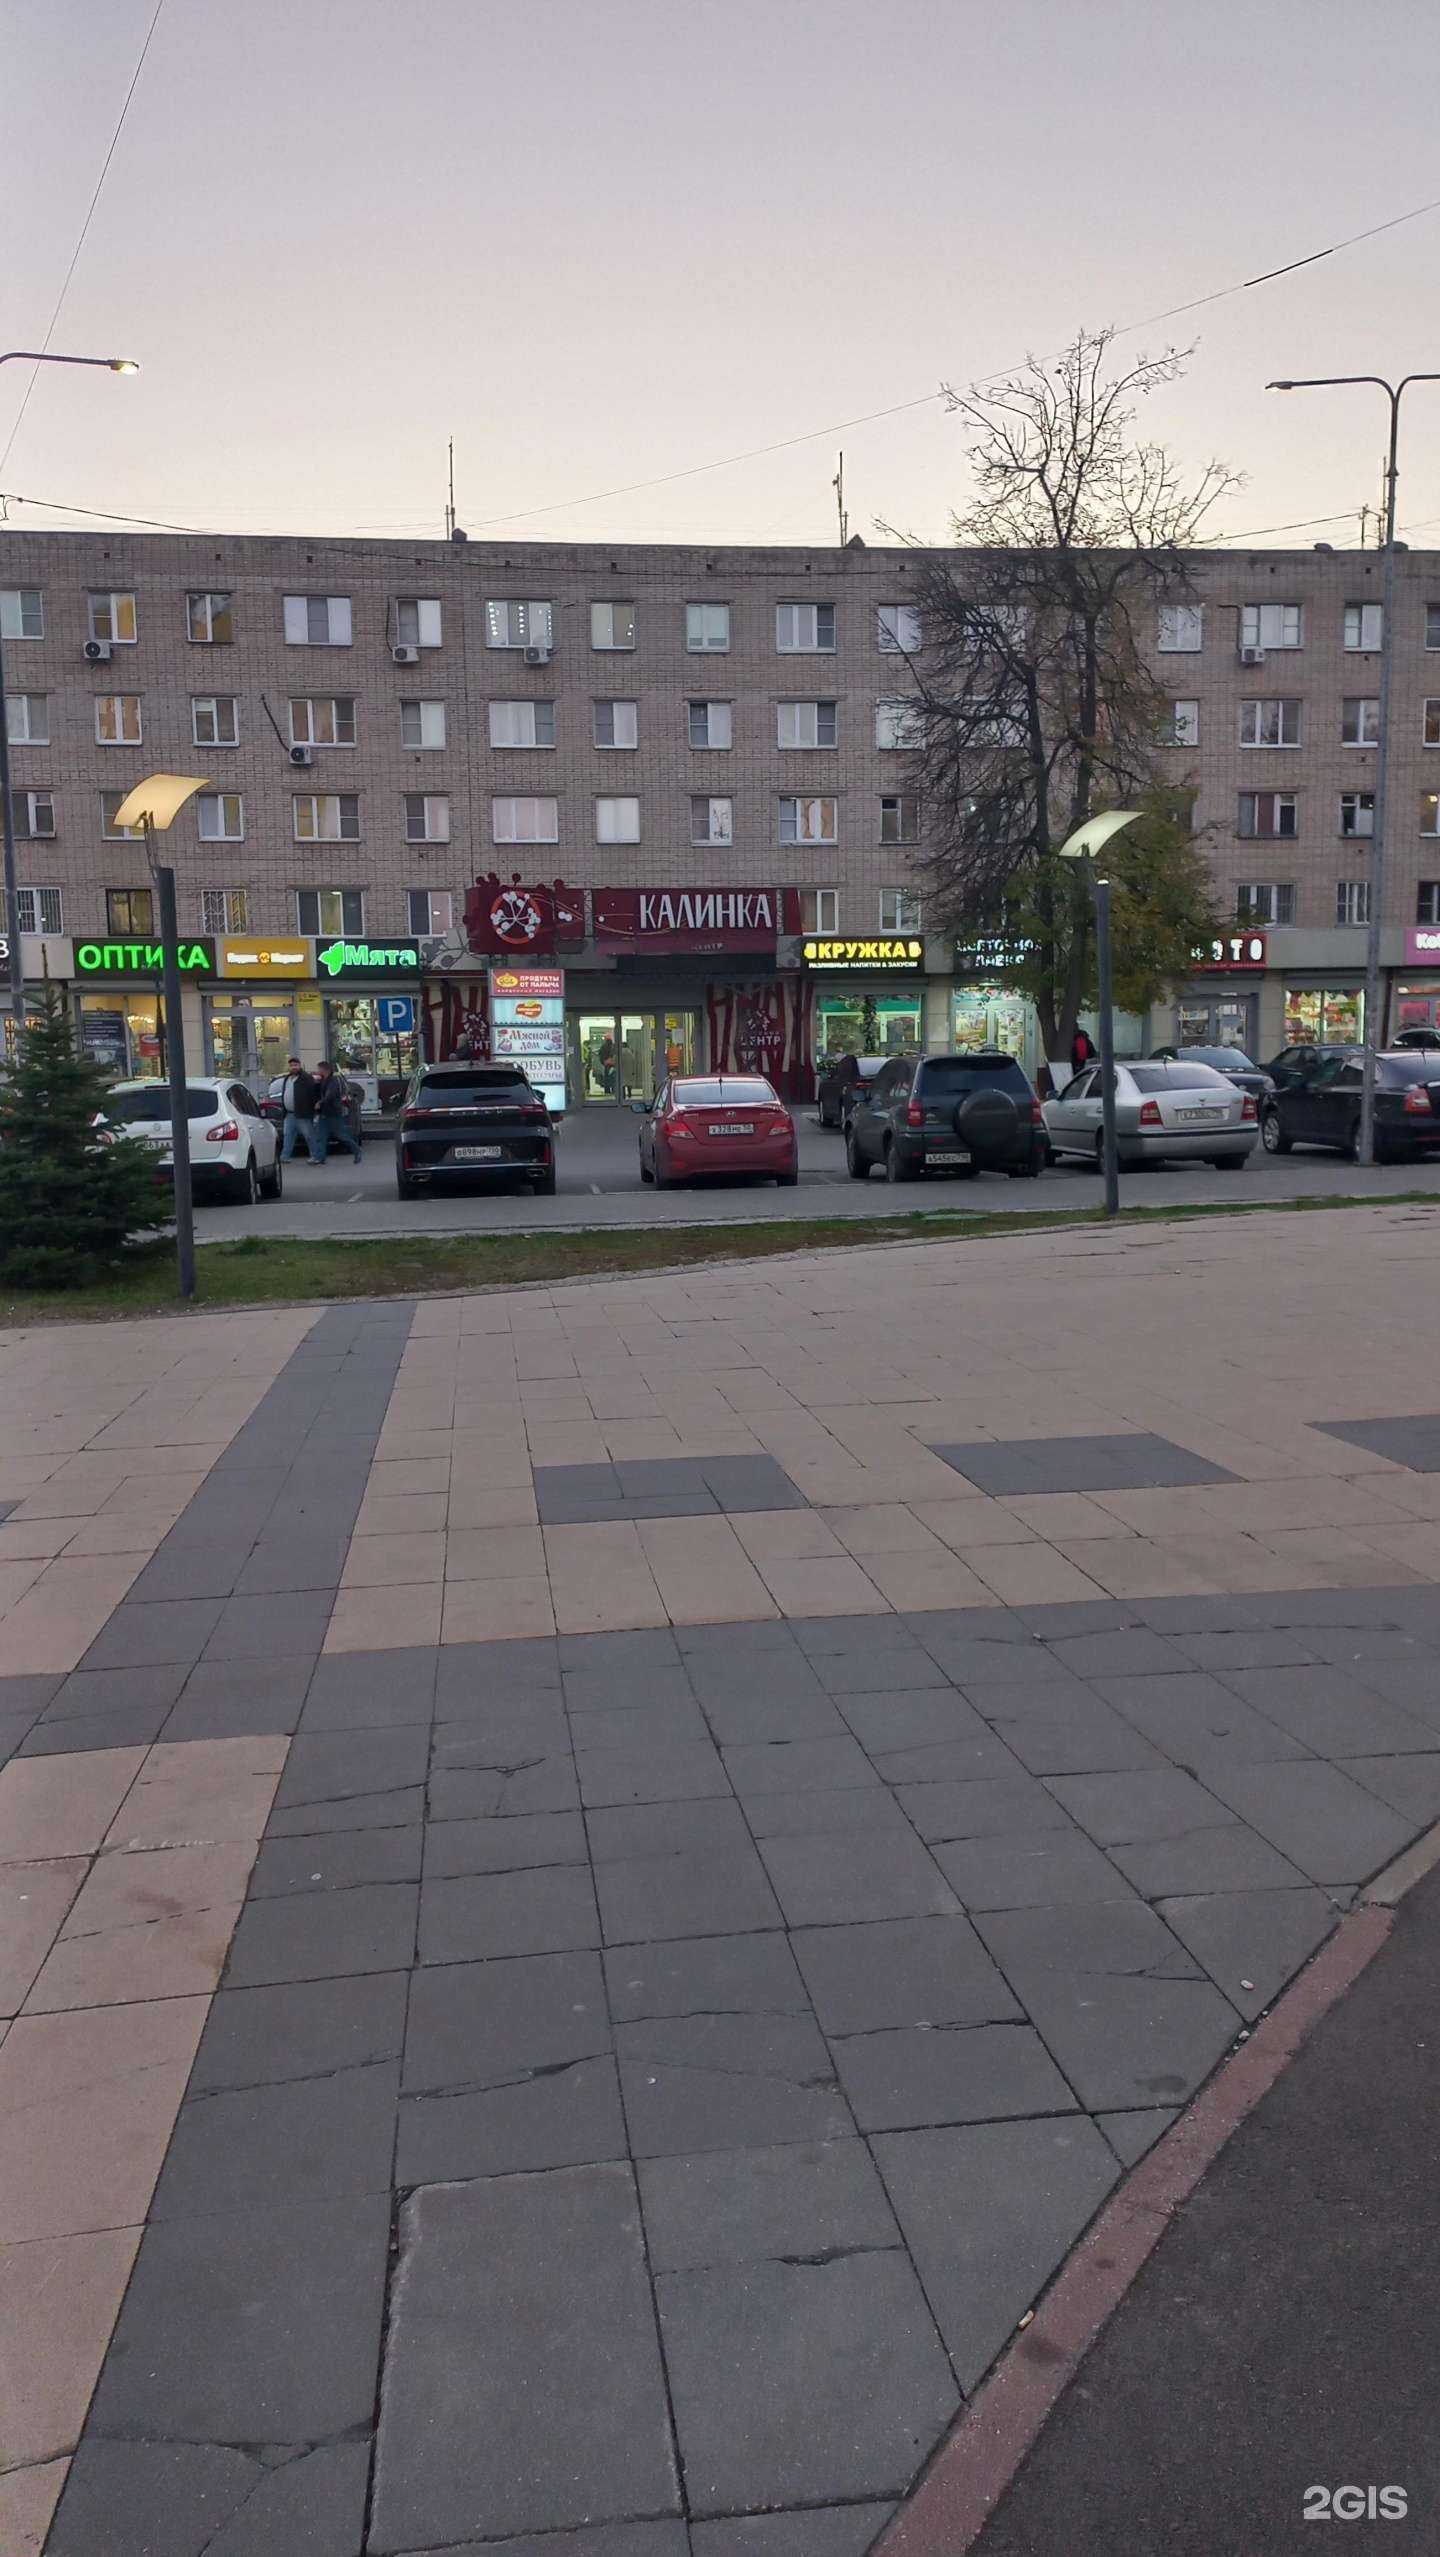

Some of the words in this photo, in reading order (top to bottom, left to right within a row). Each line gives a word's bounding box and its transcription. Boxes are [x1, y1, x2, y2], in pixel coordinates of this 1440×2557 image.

[639, 894, 772, 929] КАЛИНКА
[78, 945, 210, 969] ОПТИКА
[344, 945, 417, 966] Мята
[818, 942, 907, 959] КРУЖКА
[509, 1029, 551, 1040] Мясной
[521, 1060, 562, 1071] ОБУВЬ
